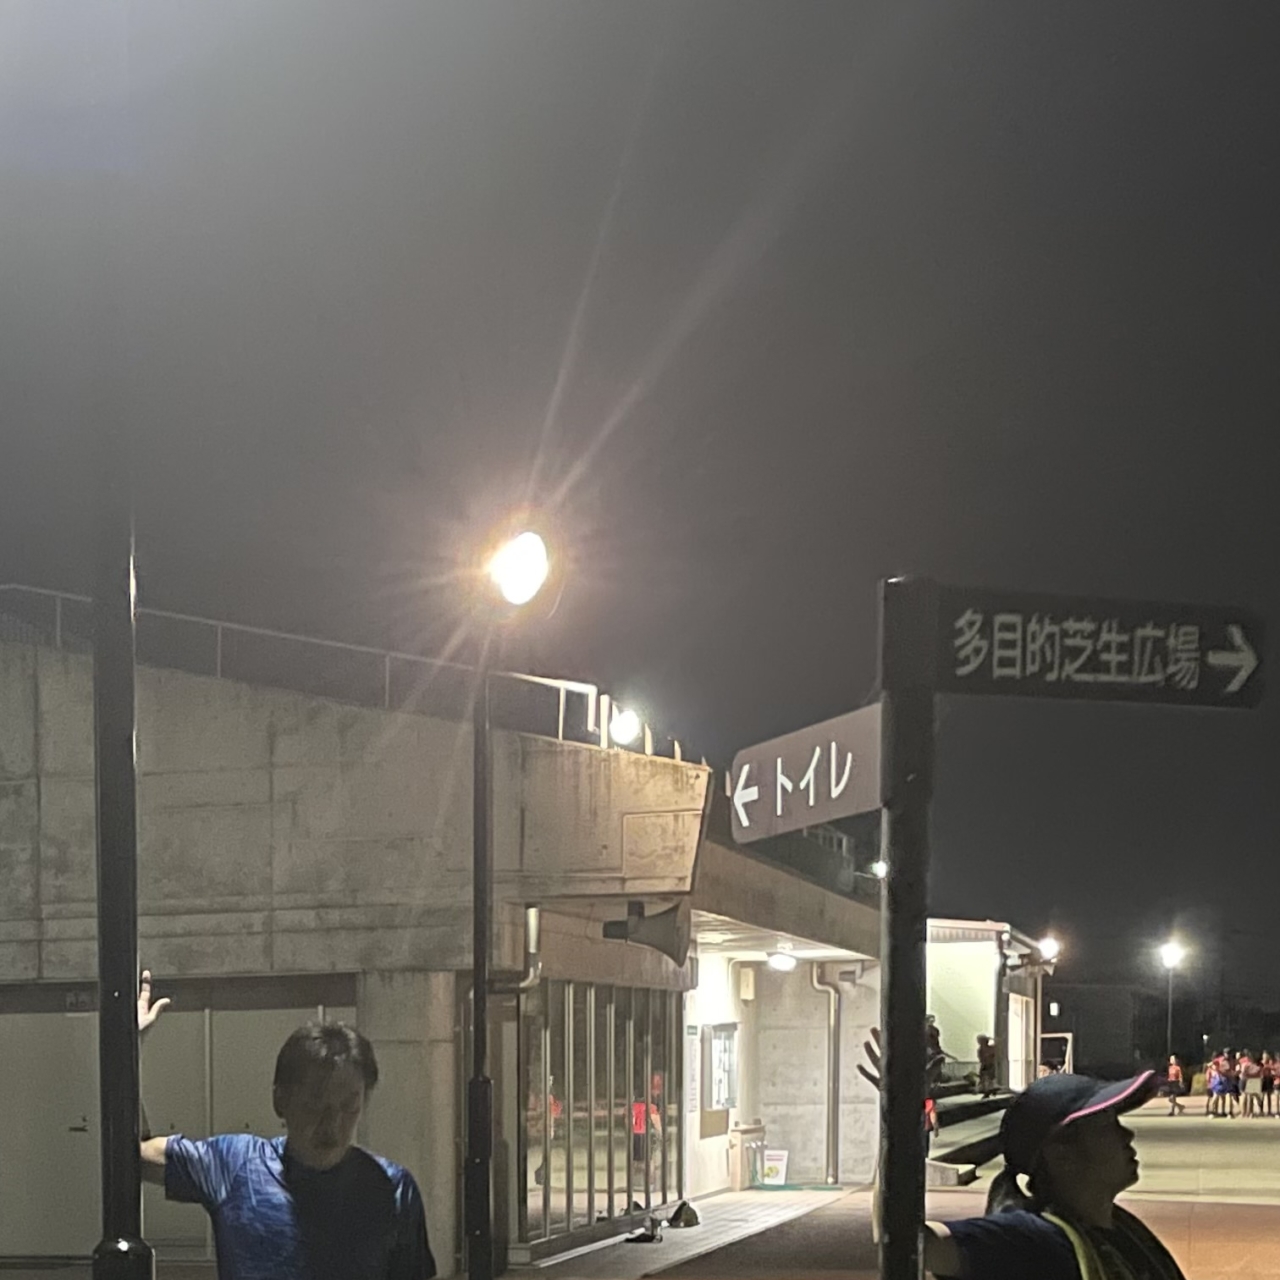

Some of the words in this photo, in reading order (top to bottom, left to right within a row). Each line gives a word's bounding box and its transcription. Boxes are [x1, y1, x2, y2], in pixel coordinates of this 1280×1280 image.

[953, 608, 1201, 690] 多目的芝生広場
[776, 741, 852, 817] トイレ
